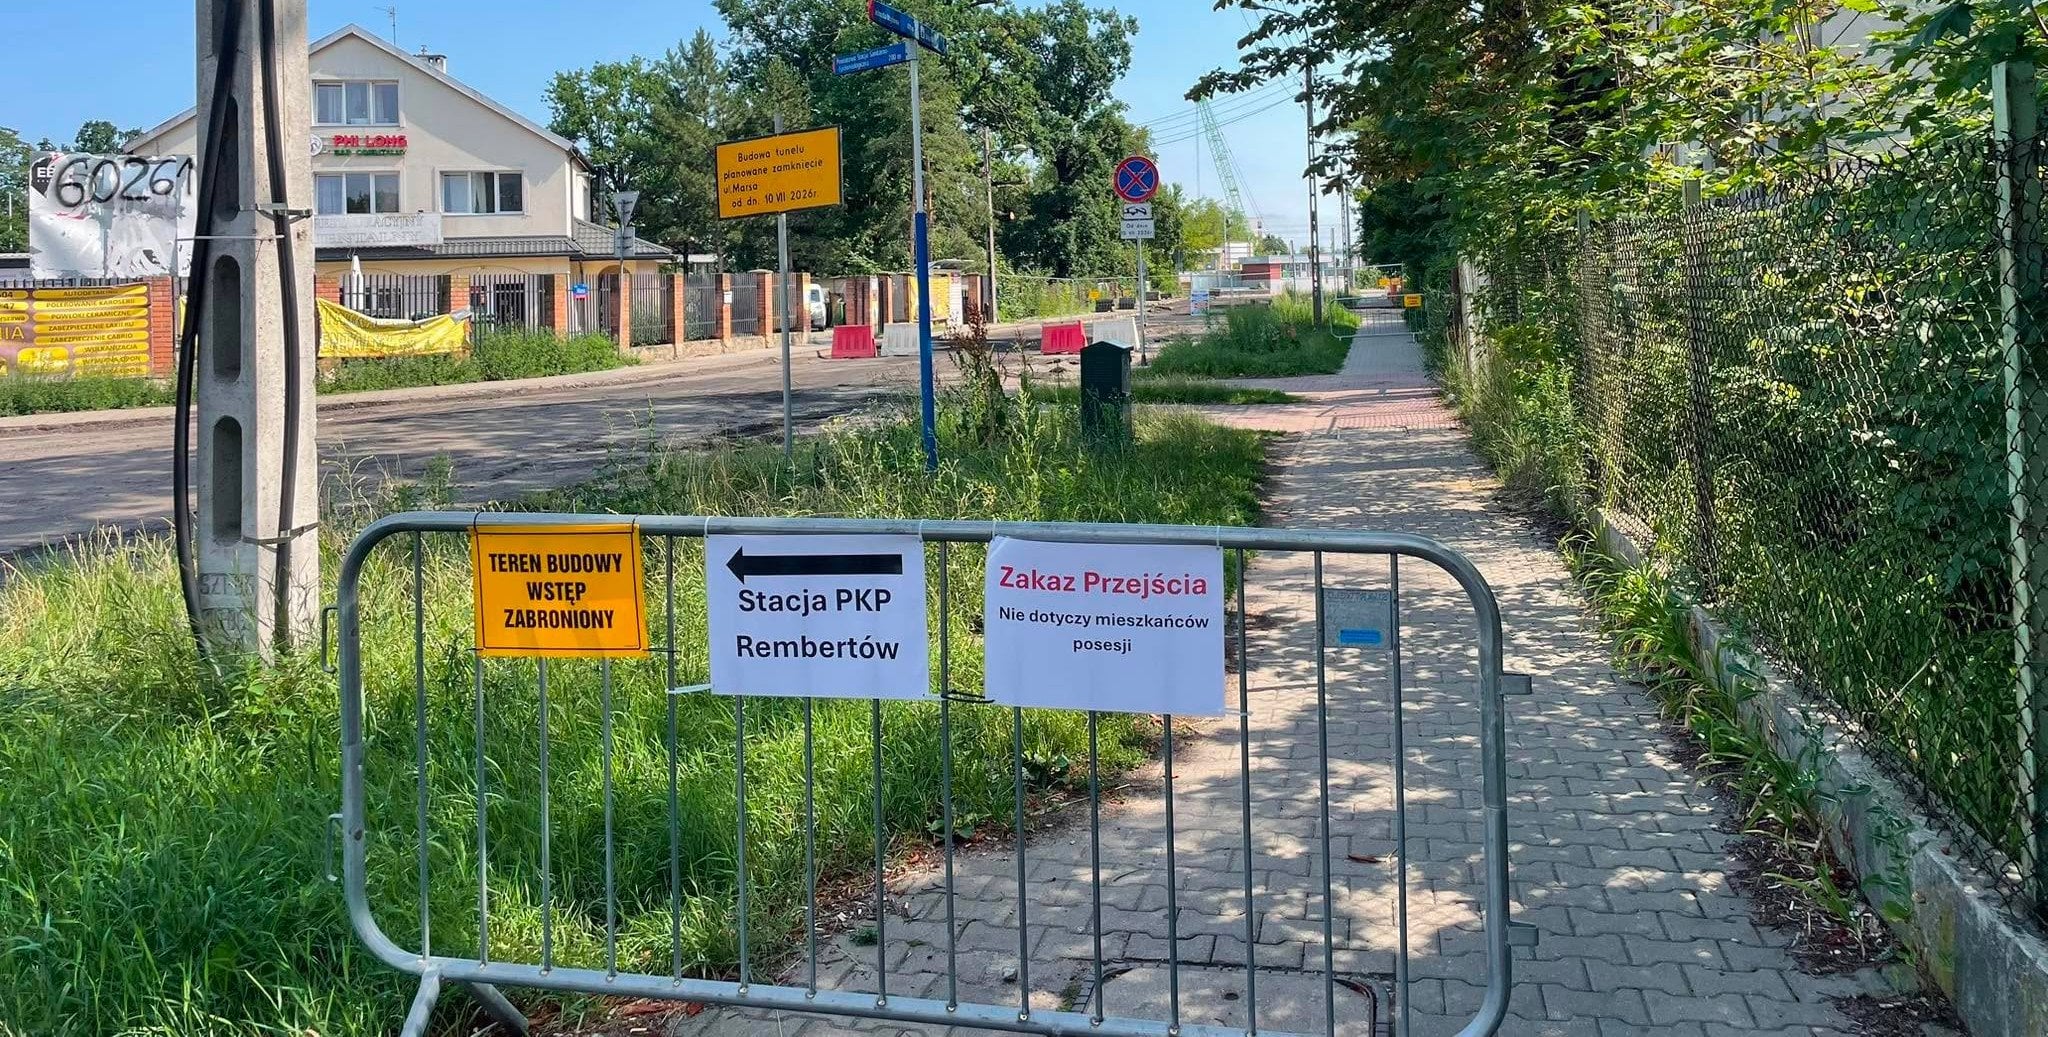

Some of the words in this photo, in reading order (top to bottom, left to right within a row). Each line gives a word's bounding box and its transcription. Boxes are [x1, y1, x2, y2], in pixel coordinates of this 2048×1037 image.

[333, 135, 359, 148] PHI
[365, 135, 407, 148] LONG
[737, 150, 771, 162] Budowa
[776, 144, 805, 157] tunelu
[723, 166, 768, 182] planowane
[772, 157, 823, 173] zamknięcie
[731, 198, 742, 208] od
[747, 197, 760, 206] dn.
[765, 193, 774, 204] 10
[776, 192, 786, 203] VII
[488, 553, 542, 573] TEREN
[547, 553, 623, 573] BUDOWY
[999, 565, 1076, 592] Zakaz
[1084, 571, 1207, 599] Przejścia
[526, 582, 587, 606] WSTĘP
[738, 588, 827, 617] Stacja
[836, 588, 892, 612] PKP
[504, 609, 614, 629] ZABRONIONY
[999, 606, 1025, 621] Nie
[1029, 609, 1091, 628] dotyczy
[1095, 613, 1209, 629] mieszkańców
[736, 635, 899, 660] Rembertów
[1073, 638, 1132, 654] posesji
